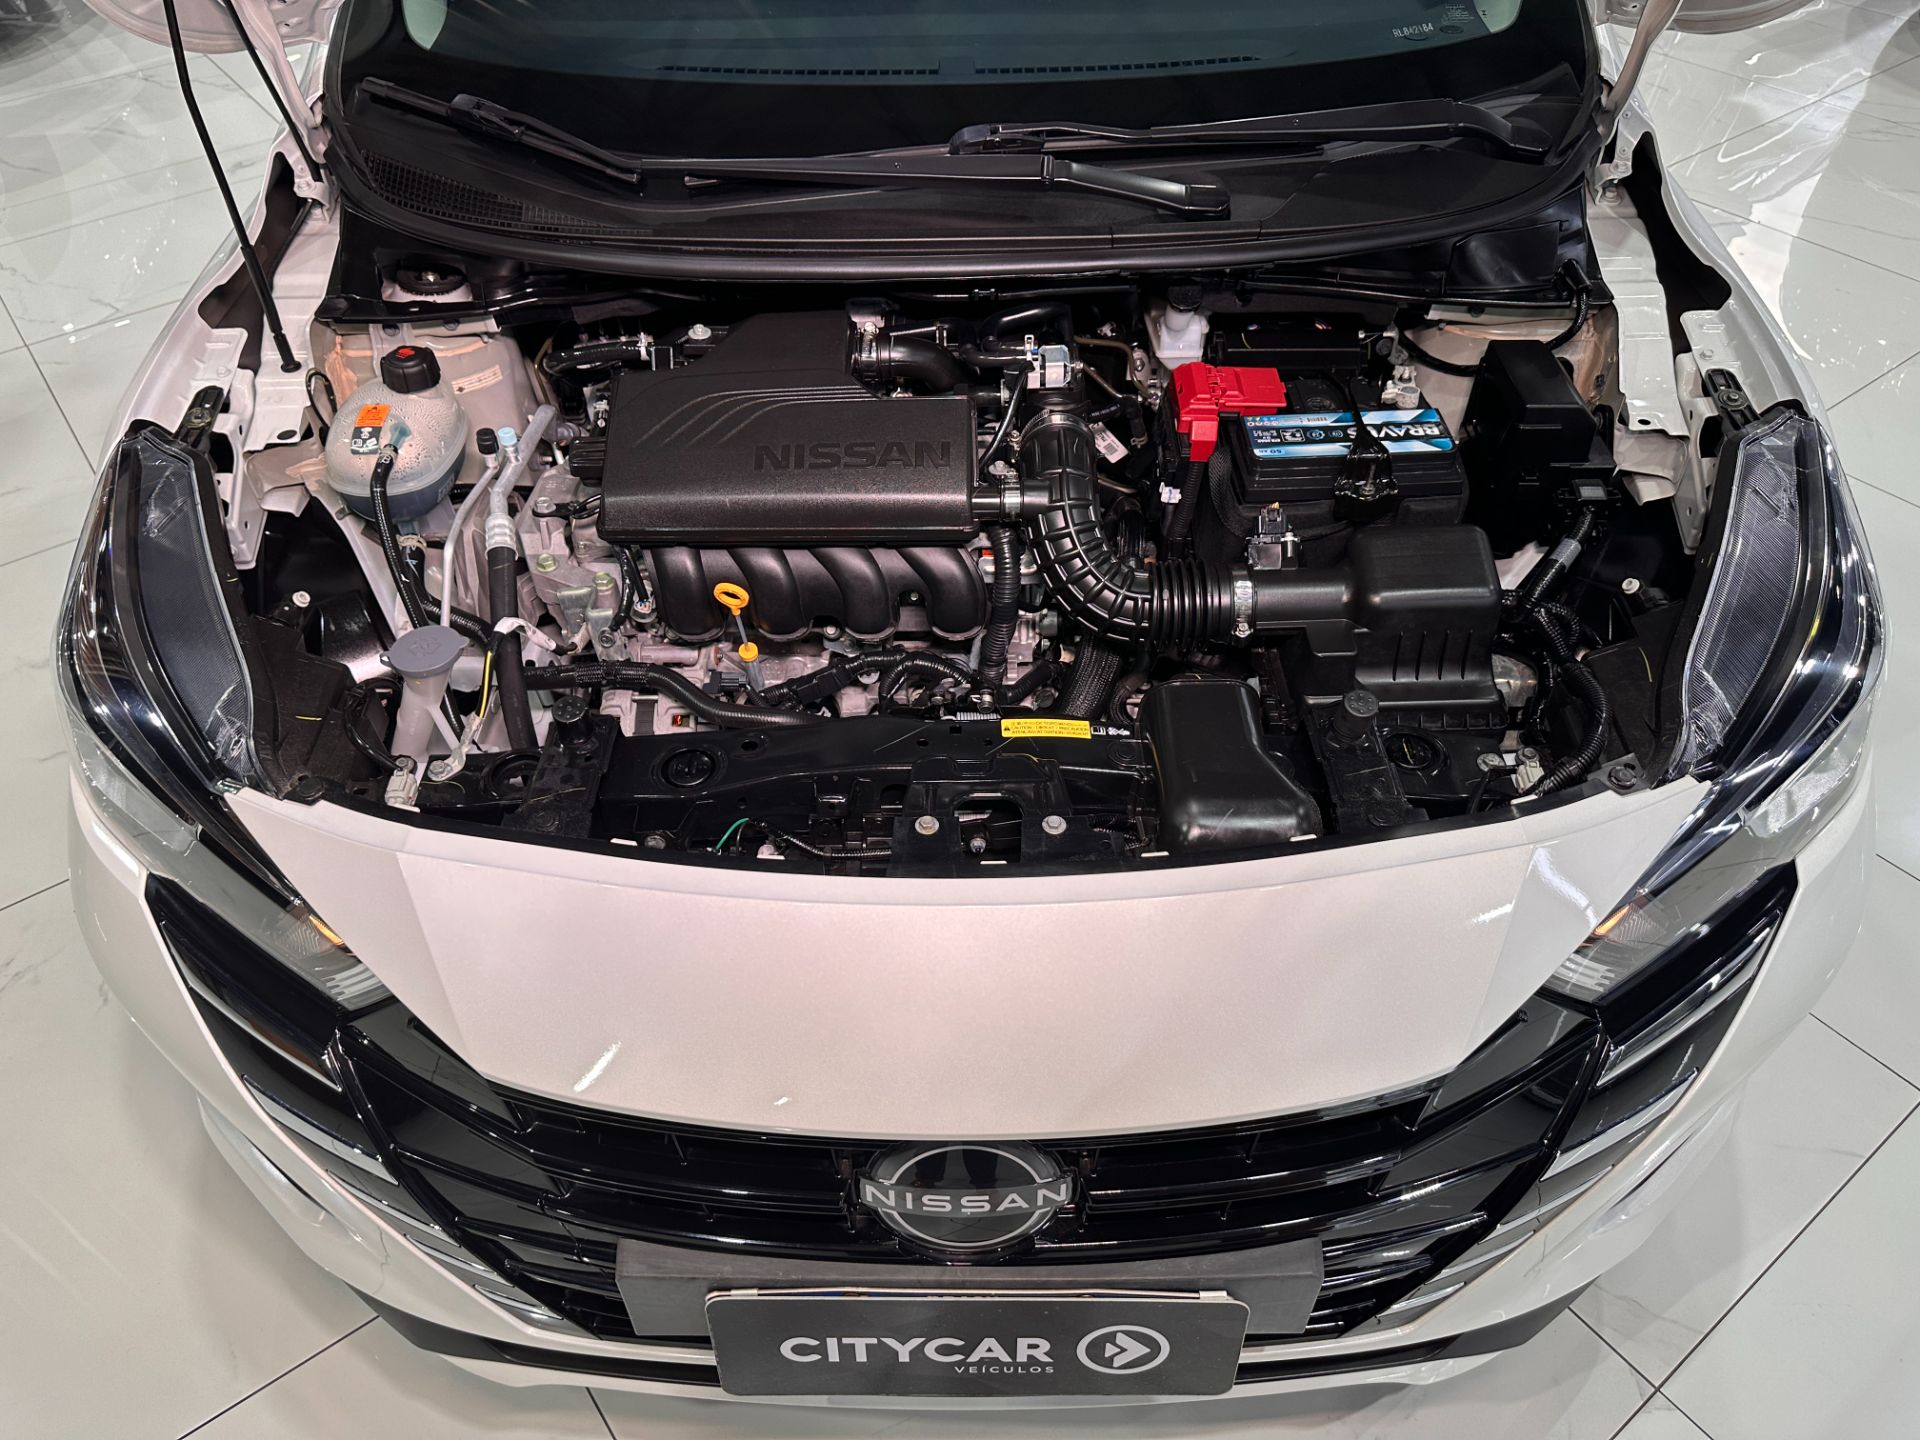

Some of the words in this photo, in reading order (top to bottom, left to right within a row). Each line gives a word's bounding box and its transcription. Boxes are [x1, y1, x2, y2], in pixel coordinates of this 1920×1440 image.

[753, 441, 951, 471] NISSAN
[865, 1183, 1067, 1212] NISSAN
[779, 1336, 1054, 1363] CITYCAR
[954, 1364, 1055, 1374] VEÍCULOS
